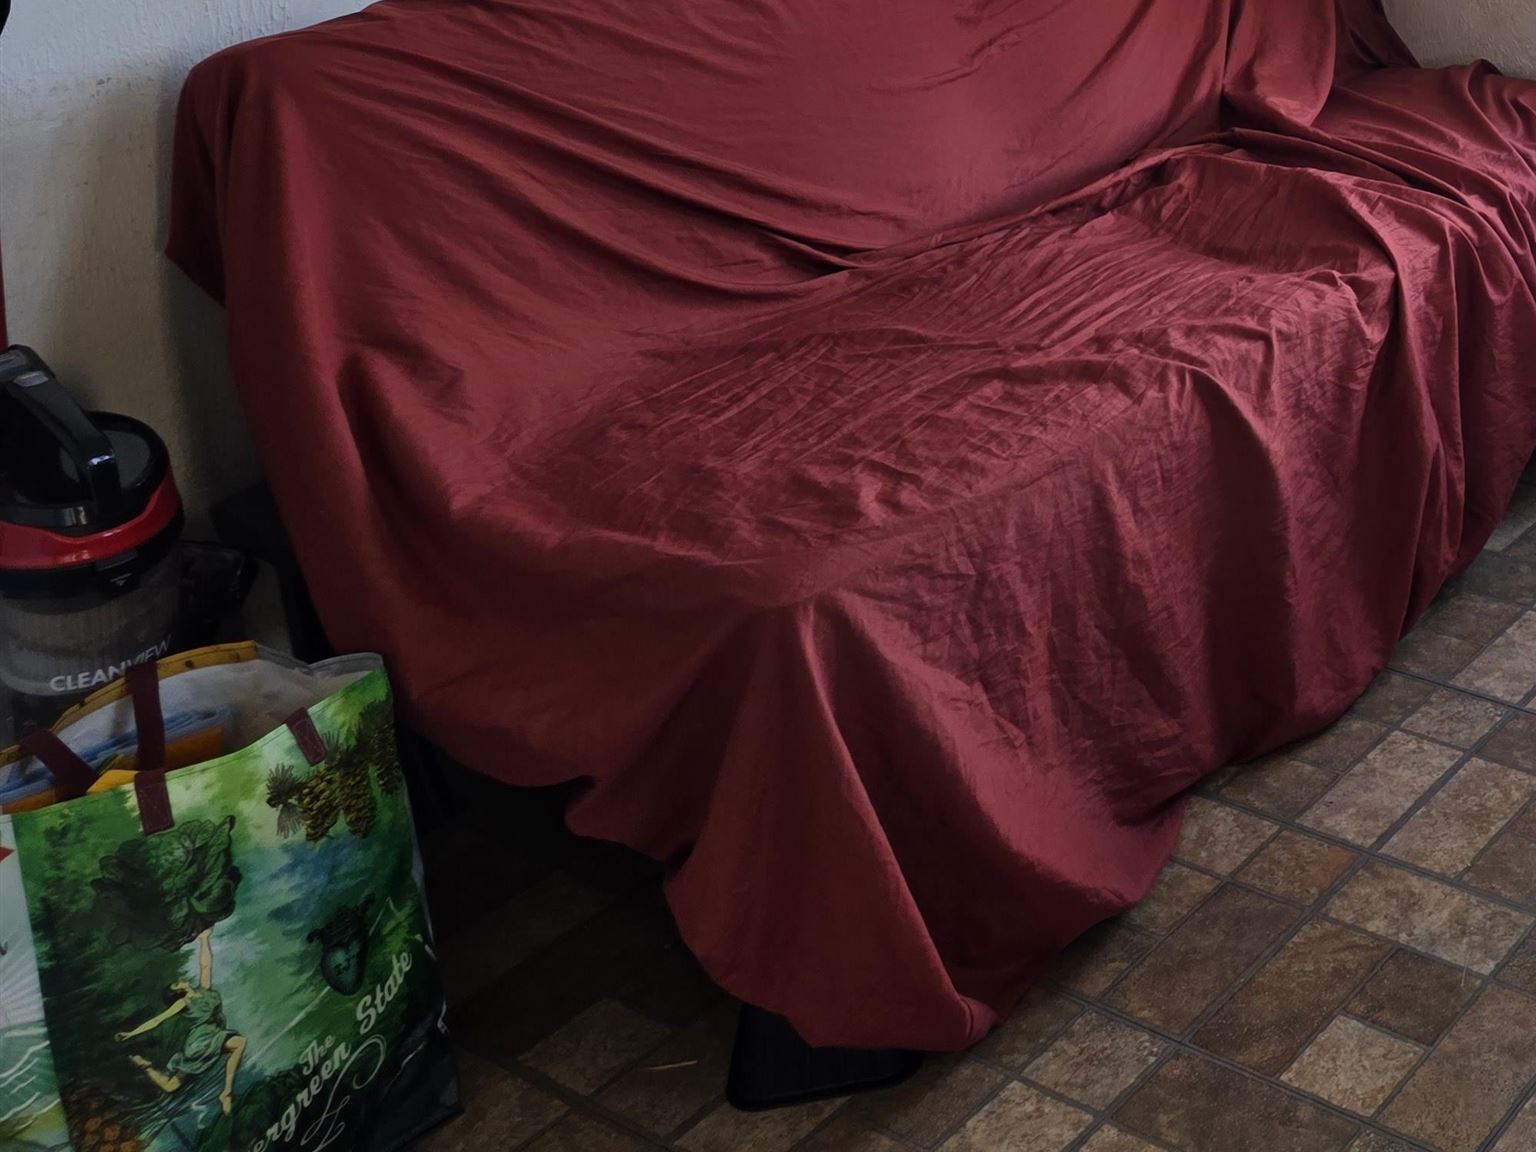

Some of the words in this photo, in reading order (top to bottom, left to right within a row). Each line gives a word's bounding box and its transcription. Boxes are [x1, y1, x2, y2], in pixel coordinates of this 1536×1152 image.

[356, 951, 413, 1035] State
[247, 1042, 352, 1152] ergreen
[300, 1034, 336, 1076] The
